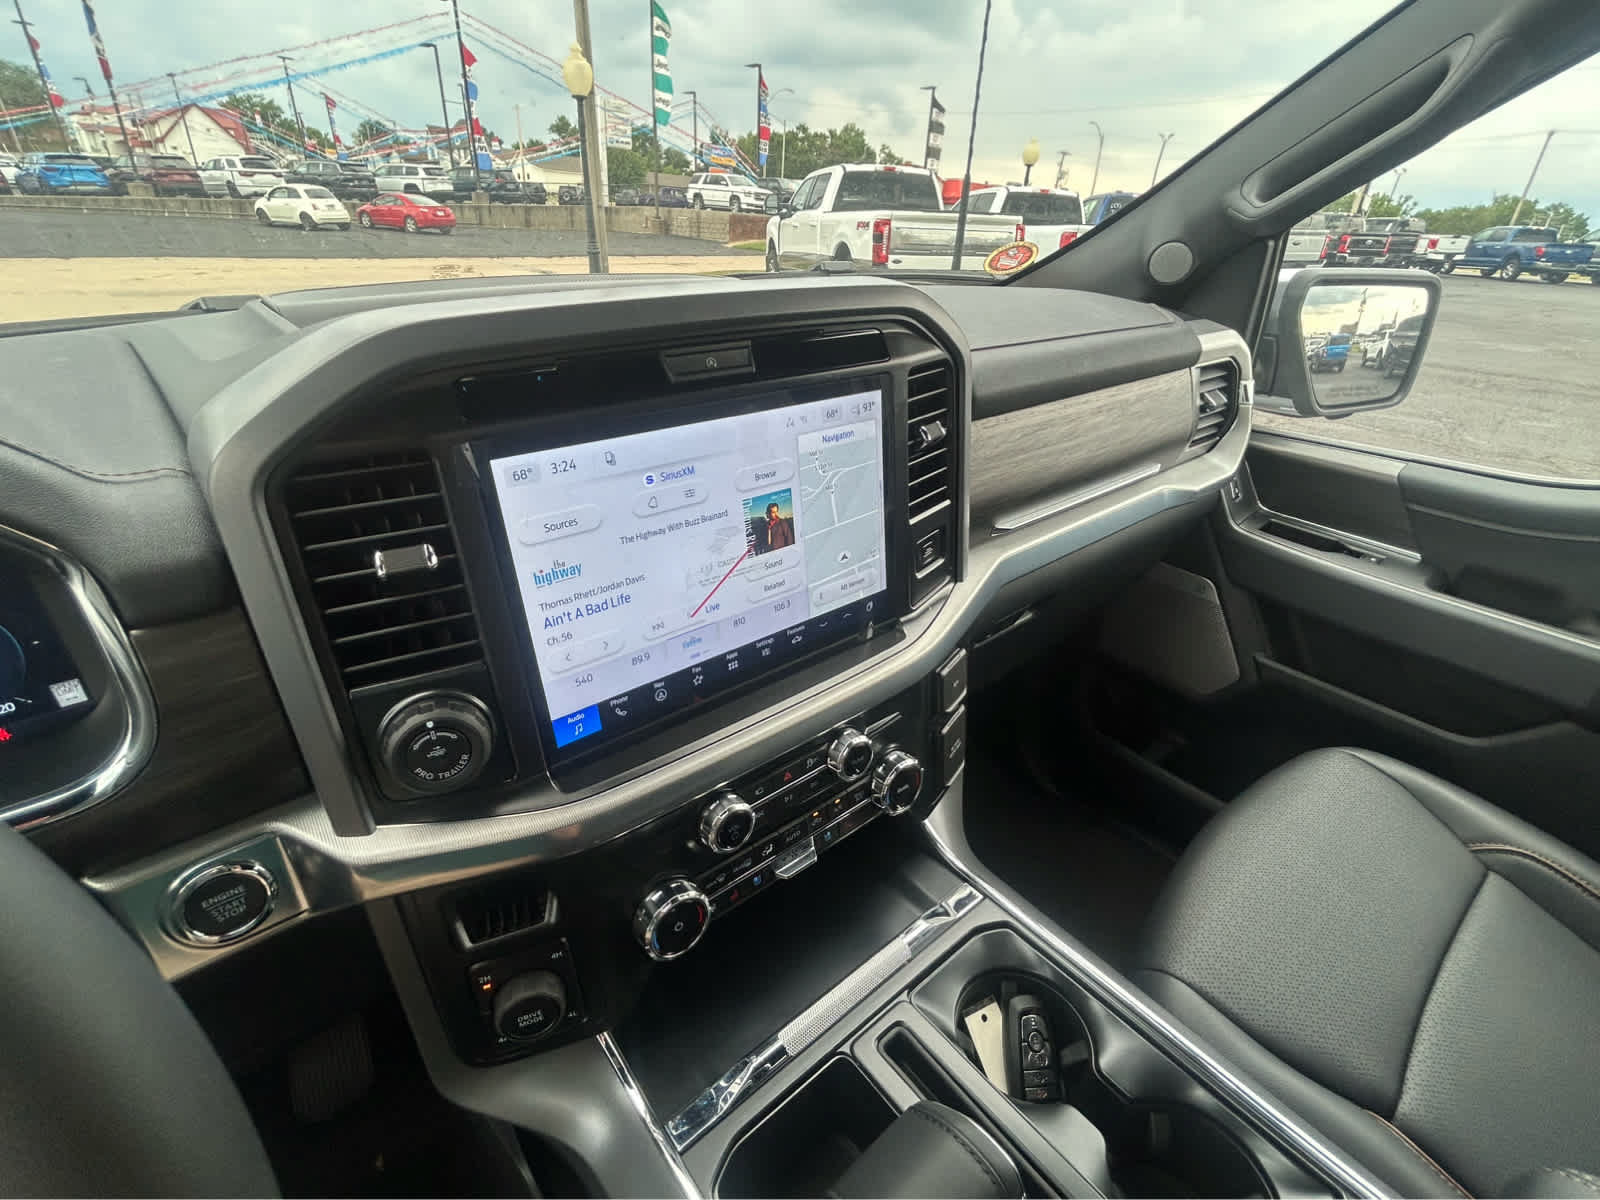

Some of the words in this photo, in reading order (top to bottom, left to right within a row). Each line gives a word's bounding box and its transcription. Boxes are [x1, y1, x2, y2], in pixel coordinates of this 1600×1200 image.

[821, 429, 855, 444] Navigation
[550, 459, 577, 475] 3:24
[659, 465, 696, 482] SiriusXM
[754, 470, 777, 482] Browse
[543, 517, 579, 533] Sources
[619, 534, 635, 545] The
[635, 527, 666, 541] Highway
[667, 520, 684, 533] With
[684, 517, 700, 528] Buzz
[700, 509, 729, 524] Brainard
[553, 559, 566, 570] the
[764, 557, 783, 570] Sound
[533, 563, 582, 585] highway
[538, 596, 574, 612] Thomas
[574, 579, 625, 602] Rhett/Jordan
[625, 573, 646, 587] Davis
[543, 609, 572, 630] Ain't
[575, 606, 585, 620] A
[585, 598, 609, 616] Bad
[610, 592, 632, 609] Life
[704, 601, 721, 614] Live
[561, 631, 573, 642] 56
[631, 652, 651, 666] 89.9
[575, 673, 593, 688] 540
[609, 695, 629, 707] Phone
[567, 712, 585, 724] Audio
[414, 766, 434, 781] PRO
[438, 754, 470, 780] TRAILER
[201, 884, 244, 909] ENGINE
[210, 897, 246, 917] START
[517, 1009, 541, 1023] DRIVE
[519, 1016, 545, 1027] MODE
